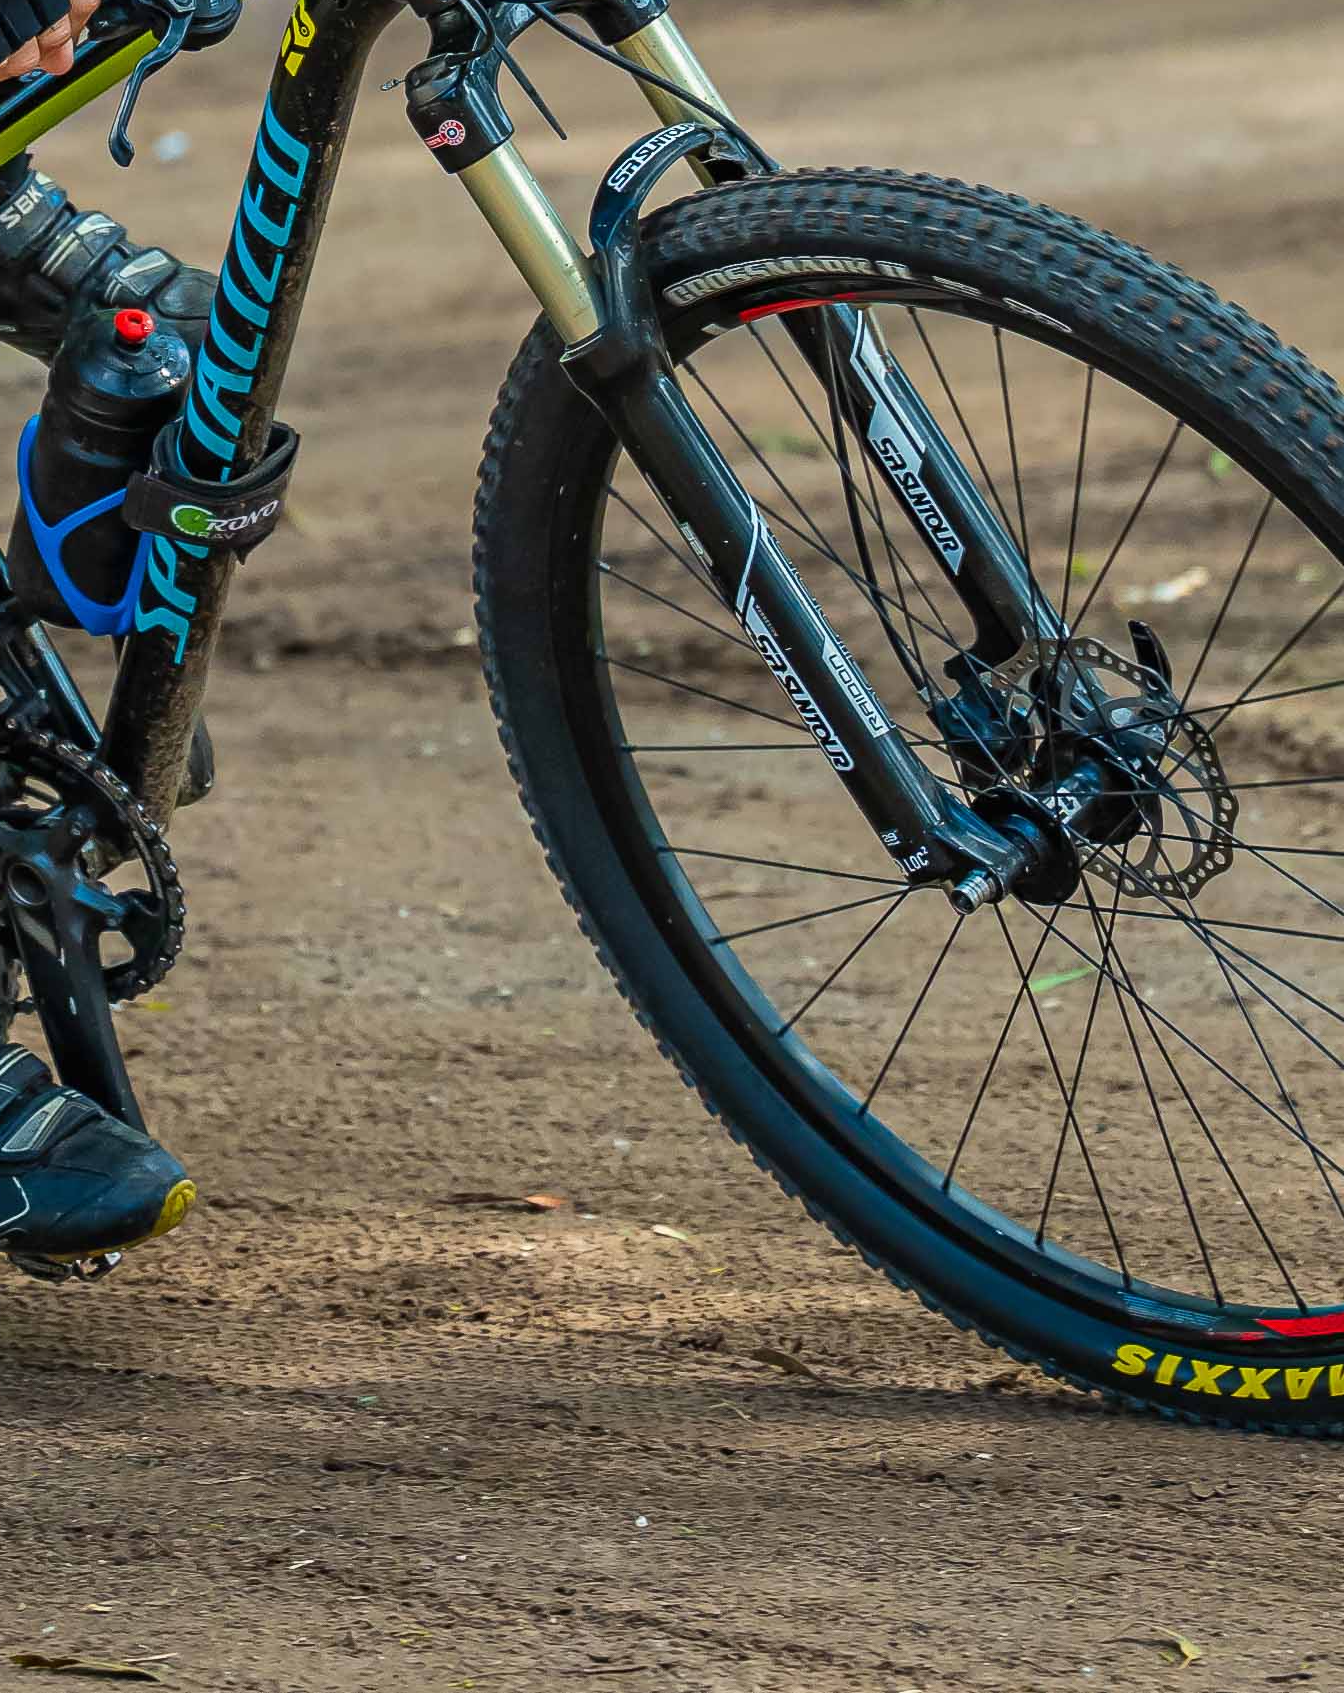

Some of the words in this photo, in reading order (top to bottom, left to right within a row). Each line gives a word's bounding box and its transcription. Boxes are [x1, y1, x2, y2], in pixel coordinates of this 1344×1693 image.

[607, 155, 642, 193] SR
[662, 254, 873, 307] CROSSMARK
[134, 89, 313, 665] SPIALIZED
[872, 436, 908, 472] SR
[896, 471, 961, 553] SUNTOUR
[756, 633, 790, 675] SR
[776, 672, 853, 771] SUNTOUR
[828, 653, 884, 733] RAIDON
